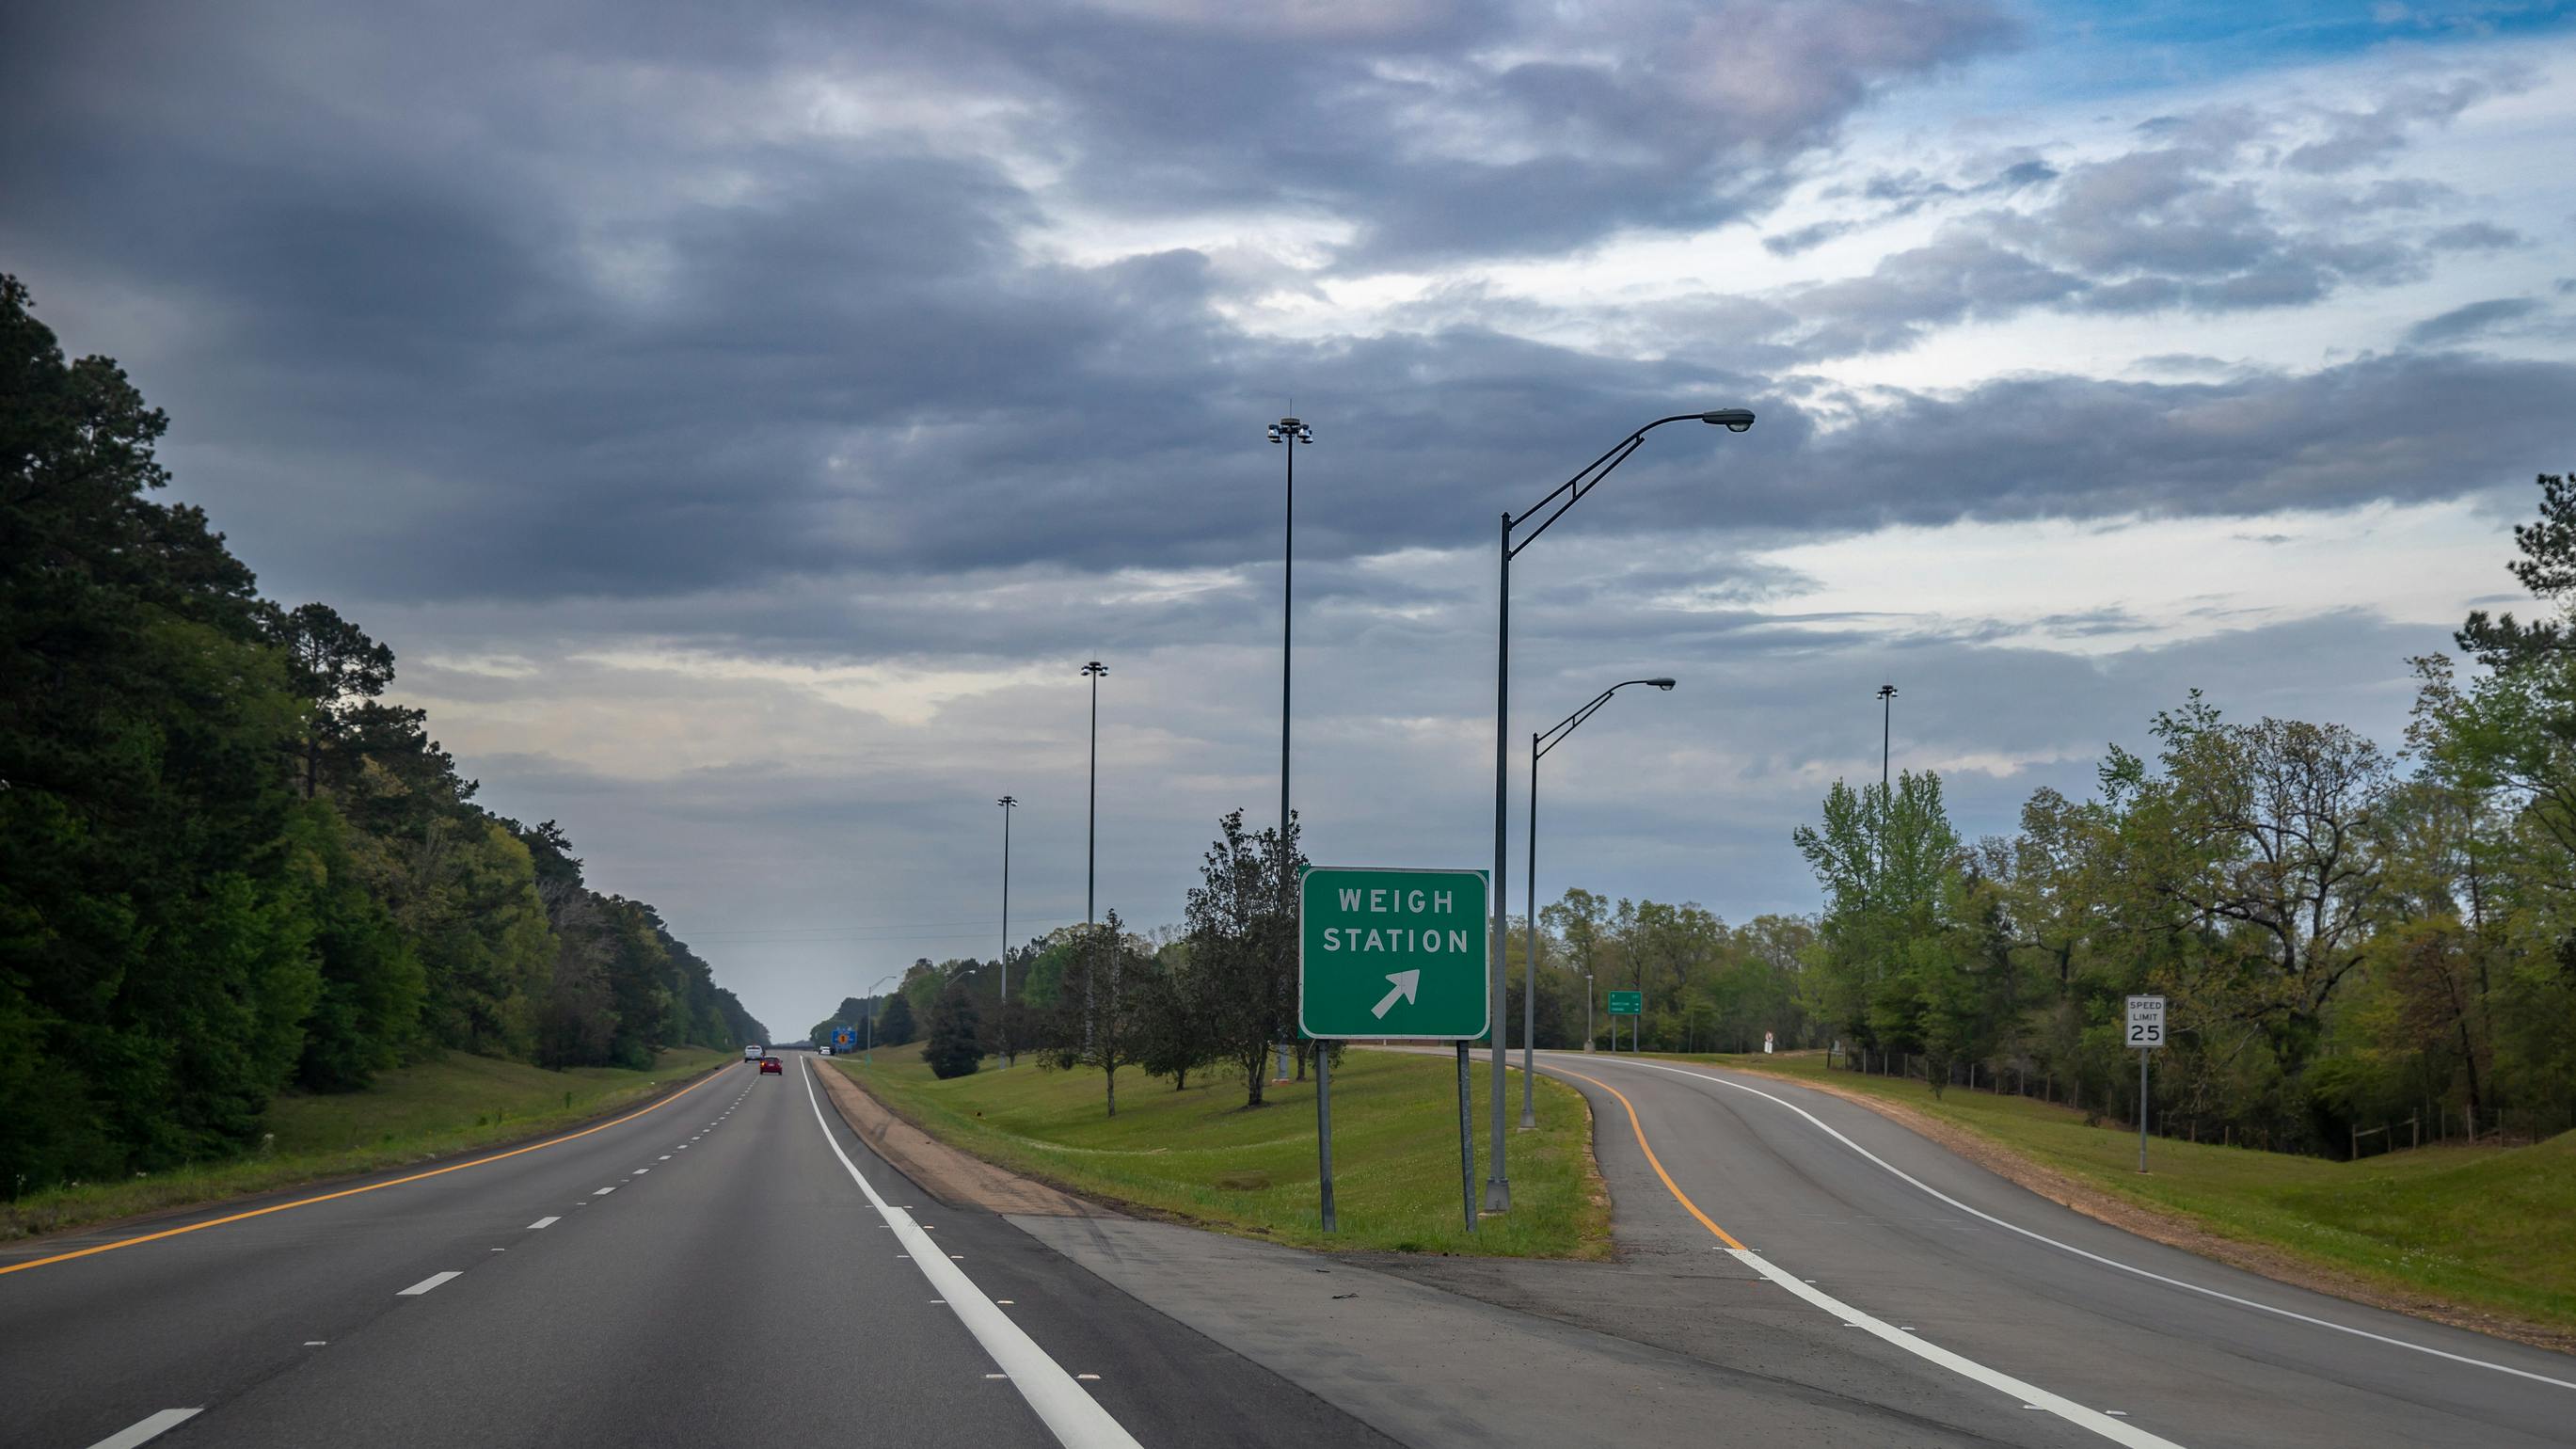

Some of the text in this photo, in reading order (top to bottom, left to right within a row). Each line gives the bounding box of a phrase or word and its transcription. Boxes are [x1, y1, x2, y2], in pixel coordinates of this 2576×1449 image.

[1339, 888, 1453, 914] WEIGH
[1323, 928, 1468, 953] STATION
[2129, 1001, 2162, 1010] SPEED
[2131, 1025, 2160, 1042] 25
